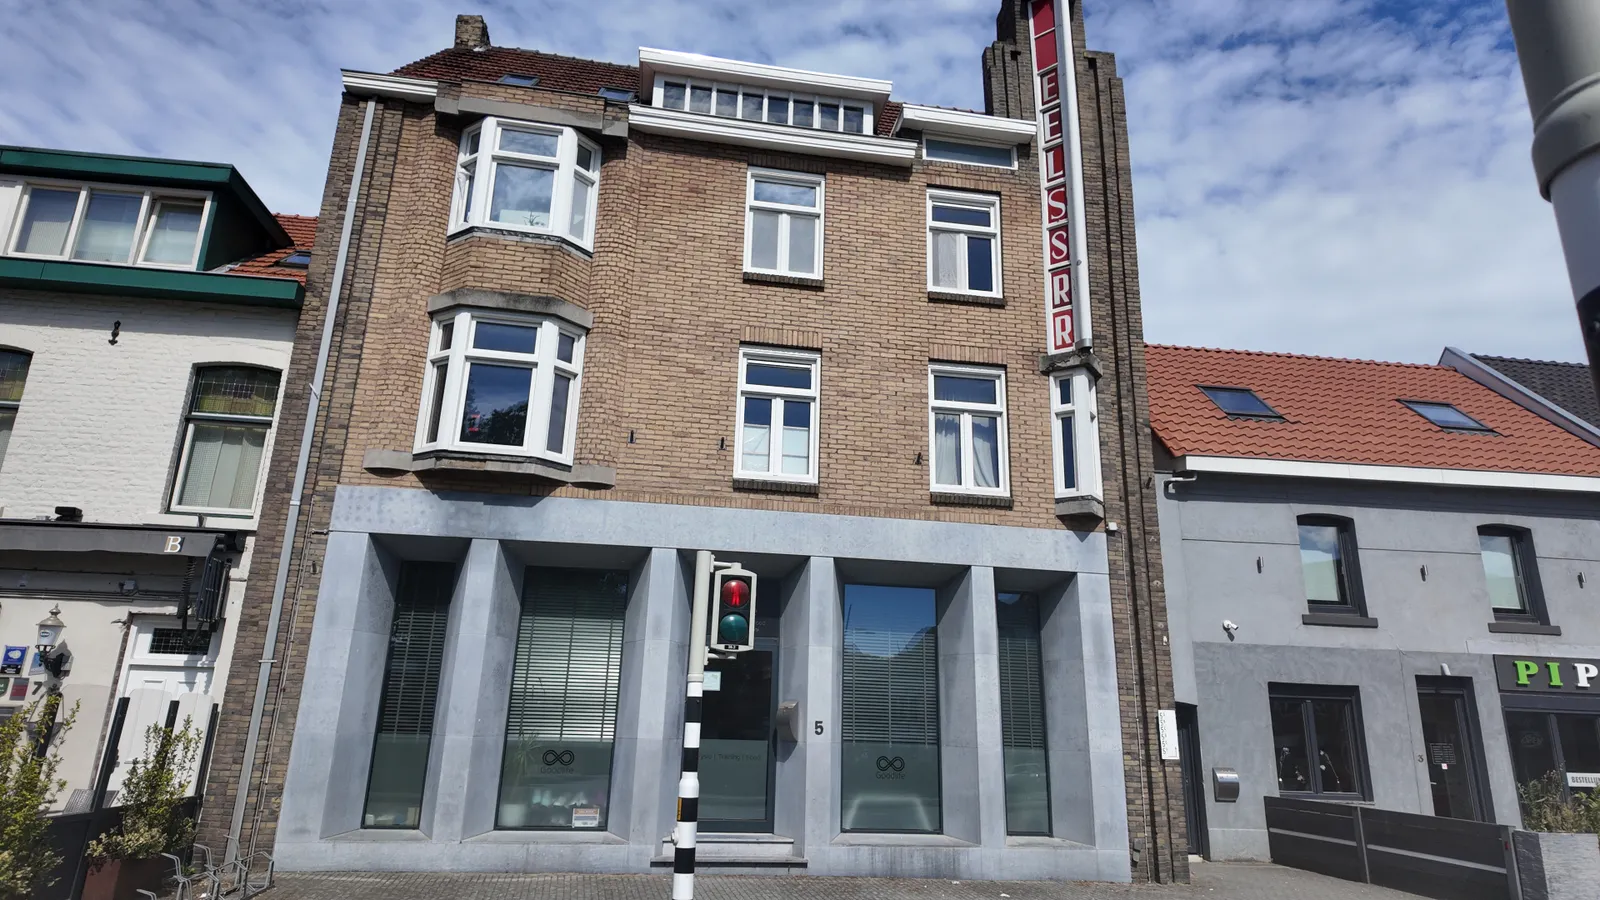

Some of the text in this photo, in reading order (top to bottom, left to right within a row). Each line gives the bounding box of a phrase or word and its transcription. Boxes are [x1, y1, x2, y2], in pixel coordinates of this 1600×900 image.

[164, 536, 182, 553] B
[32, 681, 43, 695] 7
[814, 721, 824, 735] 5
[1417, 754, 1424, 763] 3
